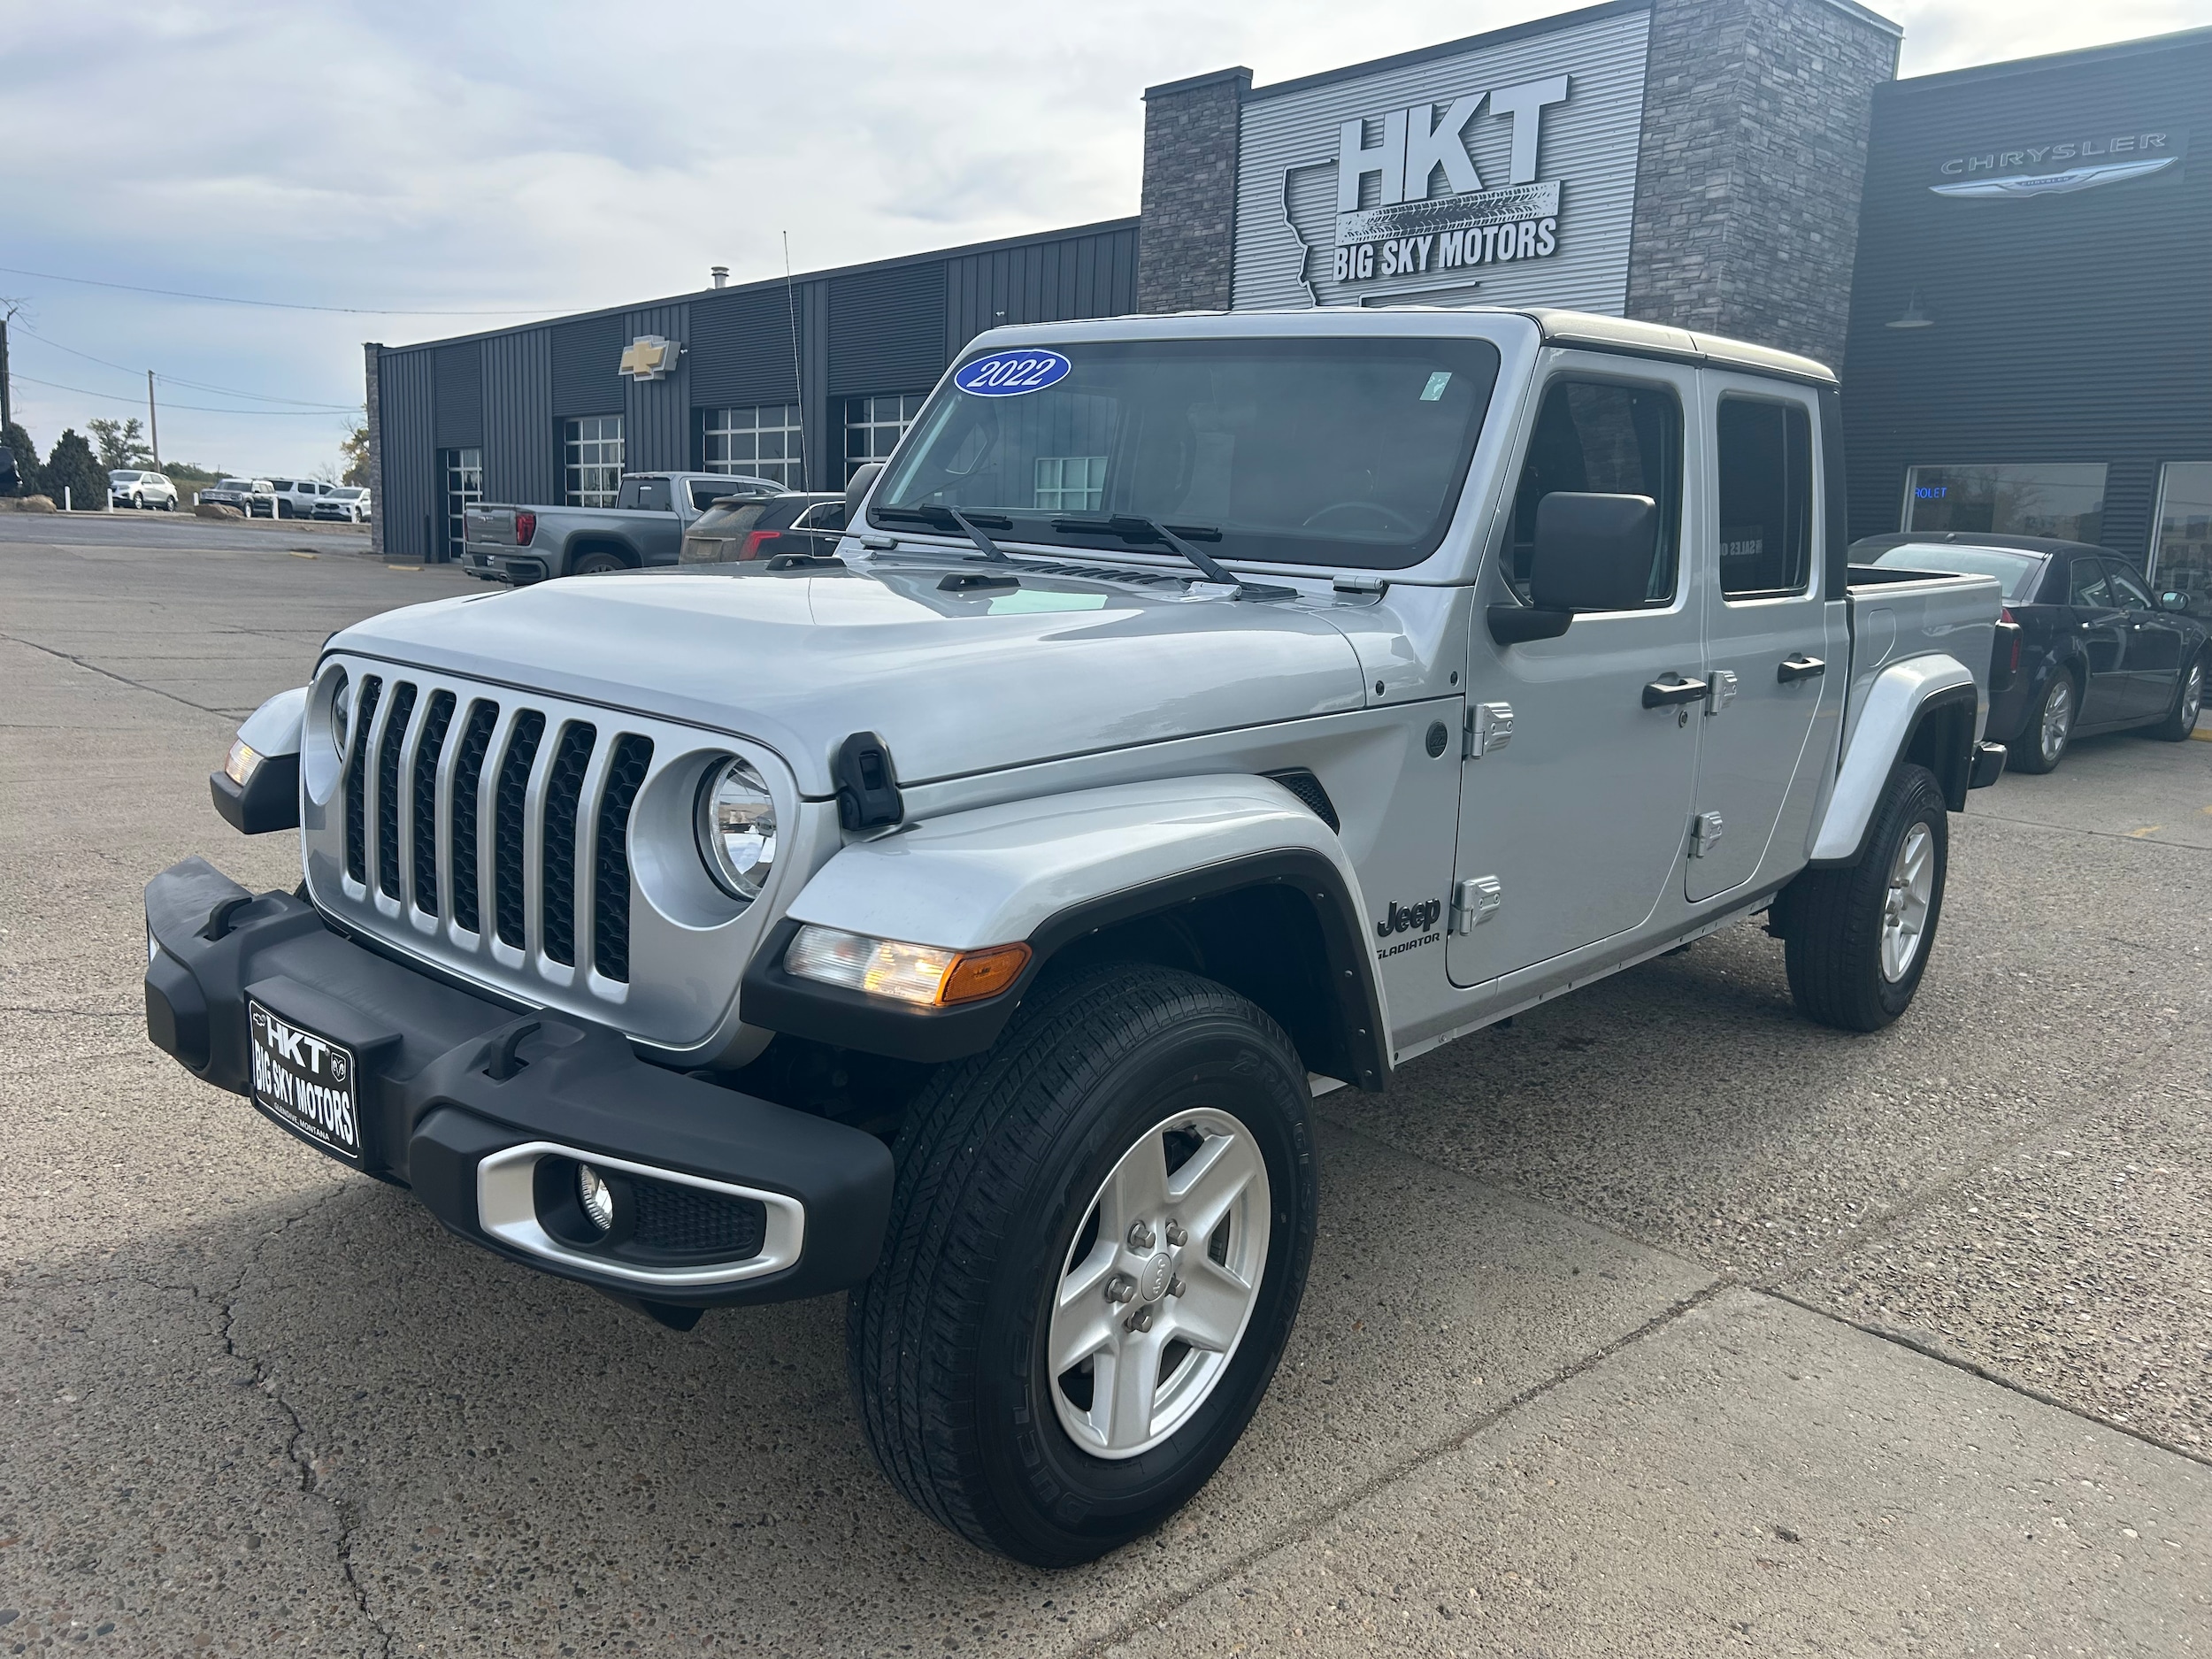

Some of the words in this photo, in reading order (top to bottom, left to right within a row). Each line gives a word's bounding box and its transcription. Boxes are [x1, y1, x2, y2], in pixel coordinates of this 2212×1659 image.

[1337, 74, 1570, 213] HKT
[1940, 133, 2167, 175] CHRYSLER
[1333, 243, 1374, 282] BIG
[1381, 234, 1435, 276] SKY
[1438, 218, 1557, 269] MOTORS
[966, 357, 1056, 388] 2022
[1377, 897, 1441, 938] Jeep
[266, 1015, 326, 1074] HKT
[255, 1039, 272, 1095] BIG
[273, 1059, 294, 1106] SKY
[296, 1076, 354, 1146] MOTORS
[299, 1120, 331, 1142] MONTANA
